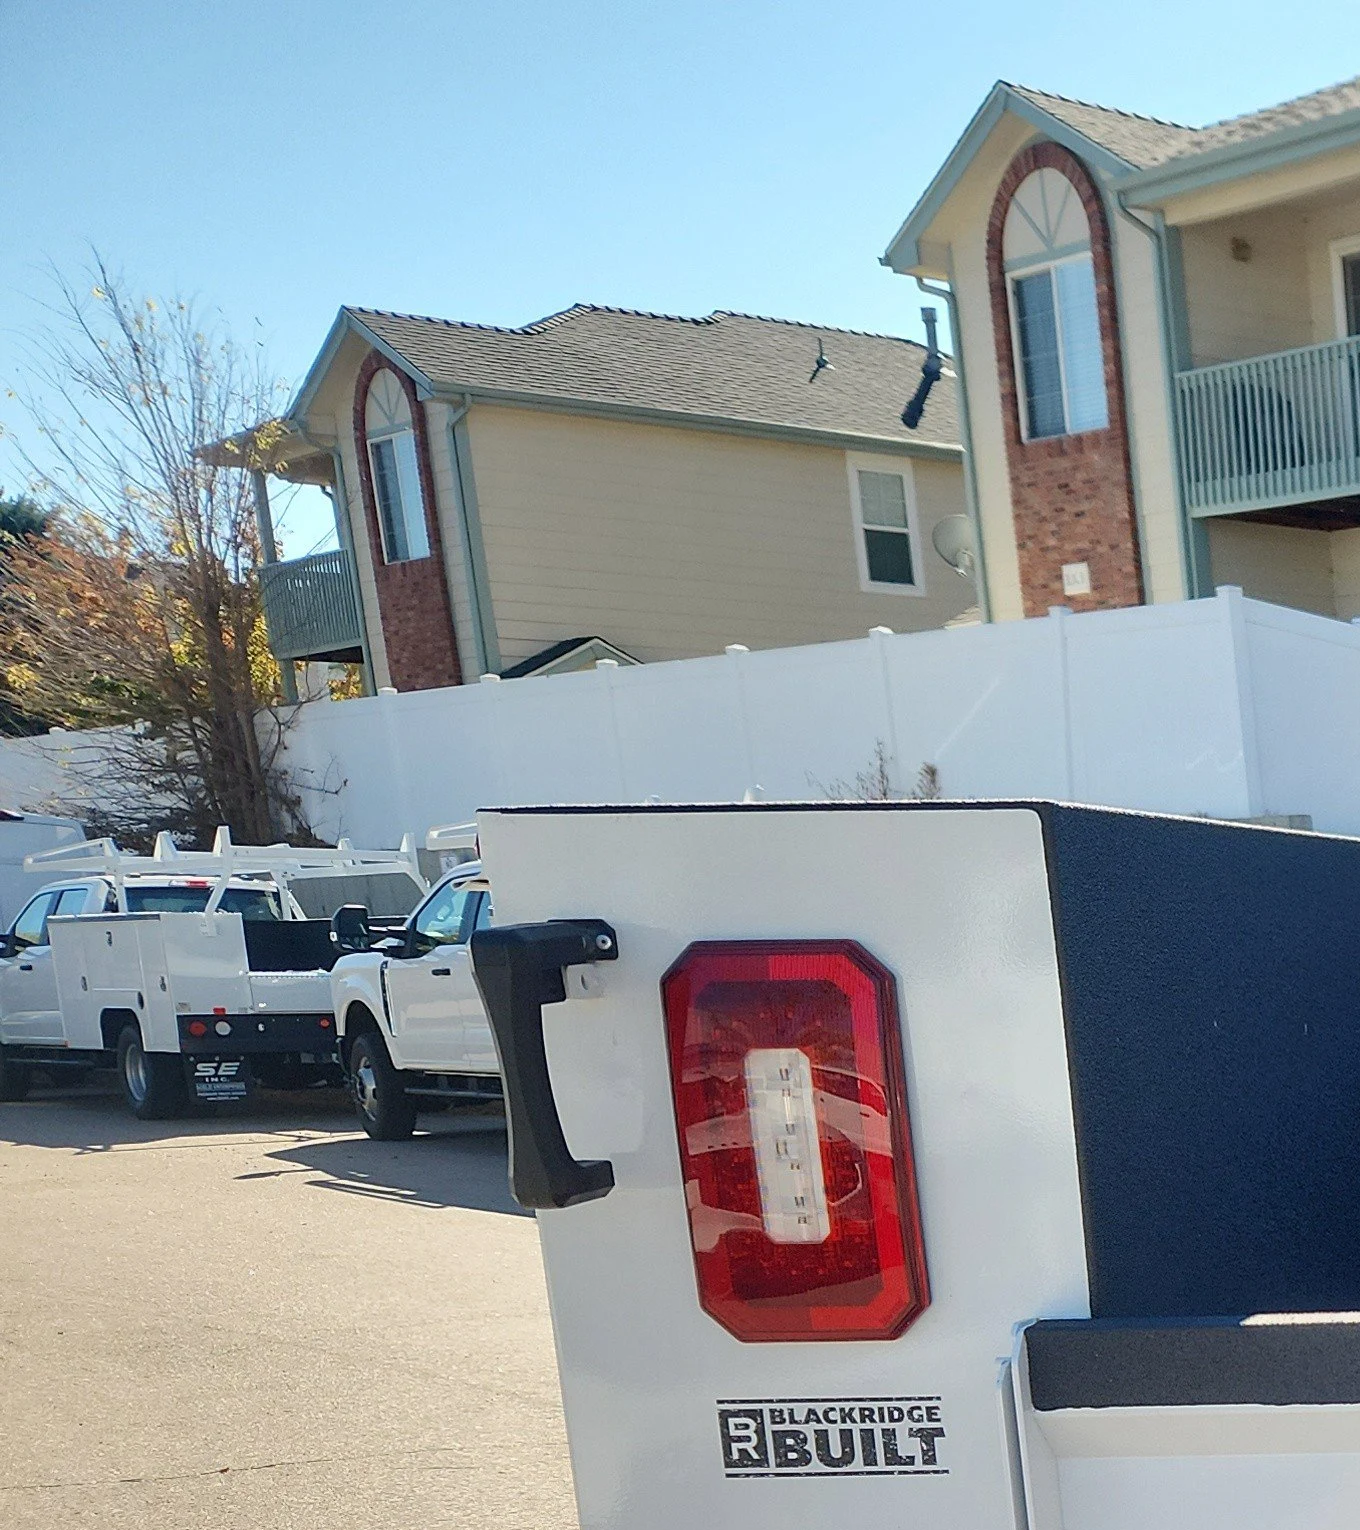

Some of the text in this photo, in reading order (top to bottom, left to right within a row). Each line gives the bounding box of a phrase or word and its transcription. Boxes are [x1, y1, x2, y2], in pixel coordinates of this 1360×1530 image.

[194, 1061, 240, 1076] SE
[769, 1405, 942, 1426] BLACKRIDGE
[771, 1427, 946, 1468] BUILT
